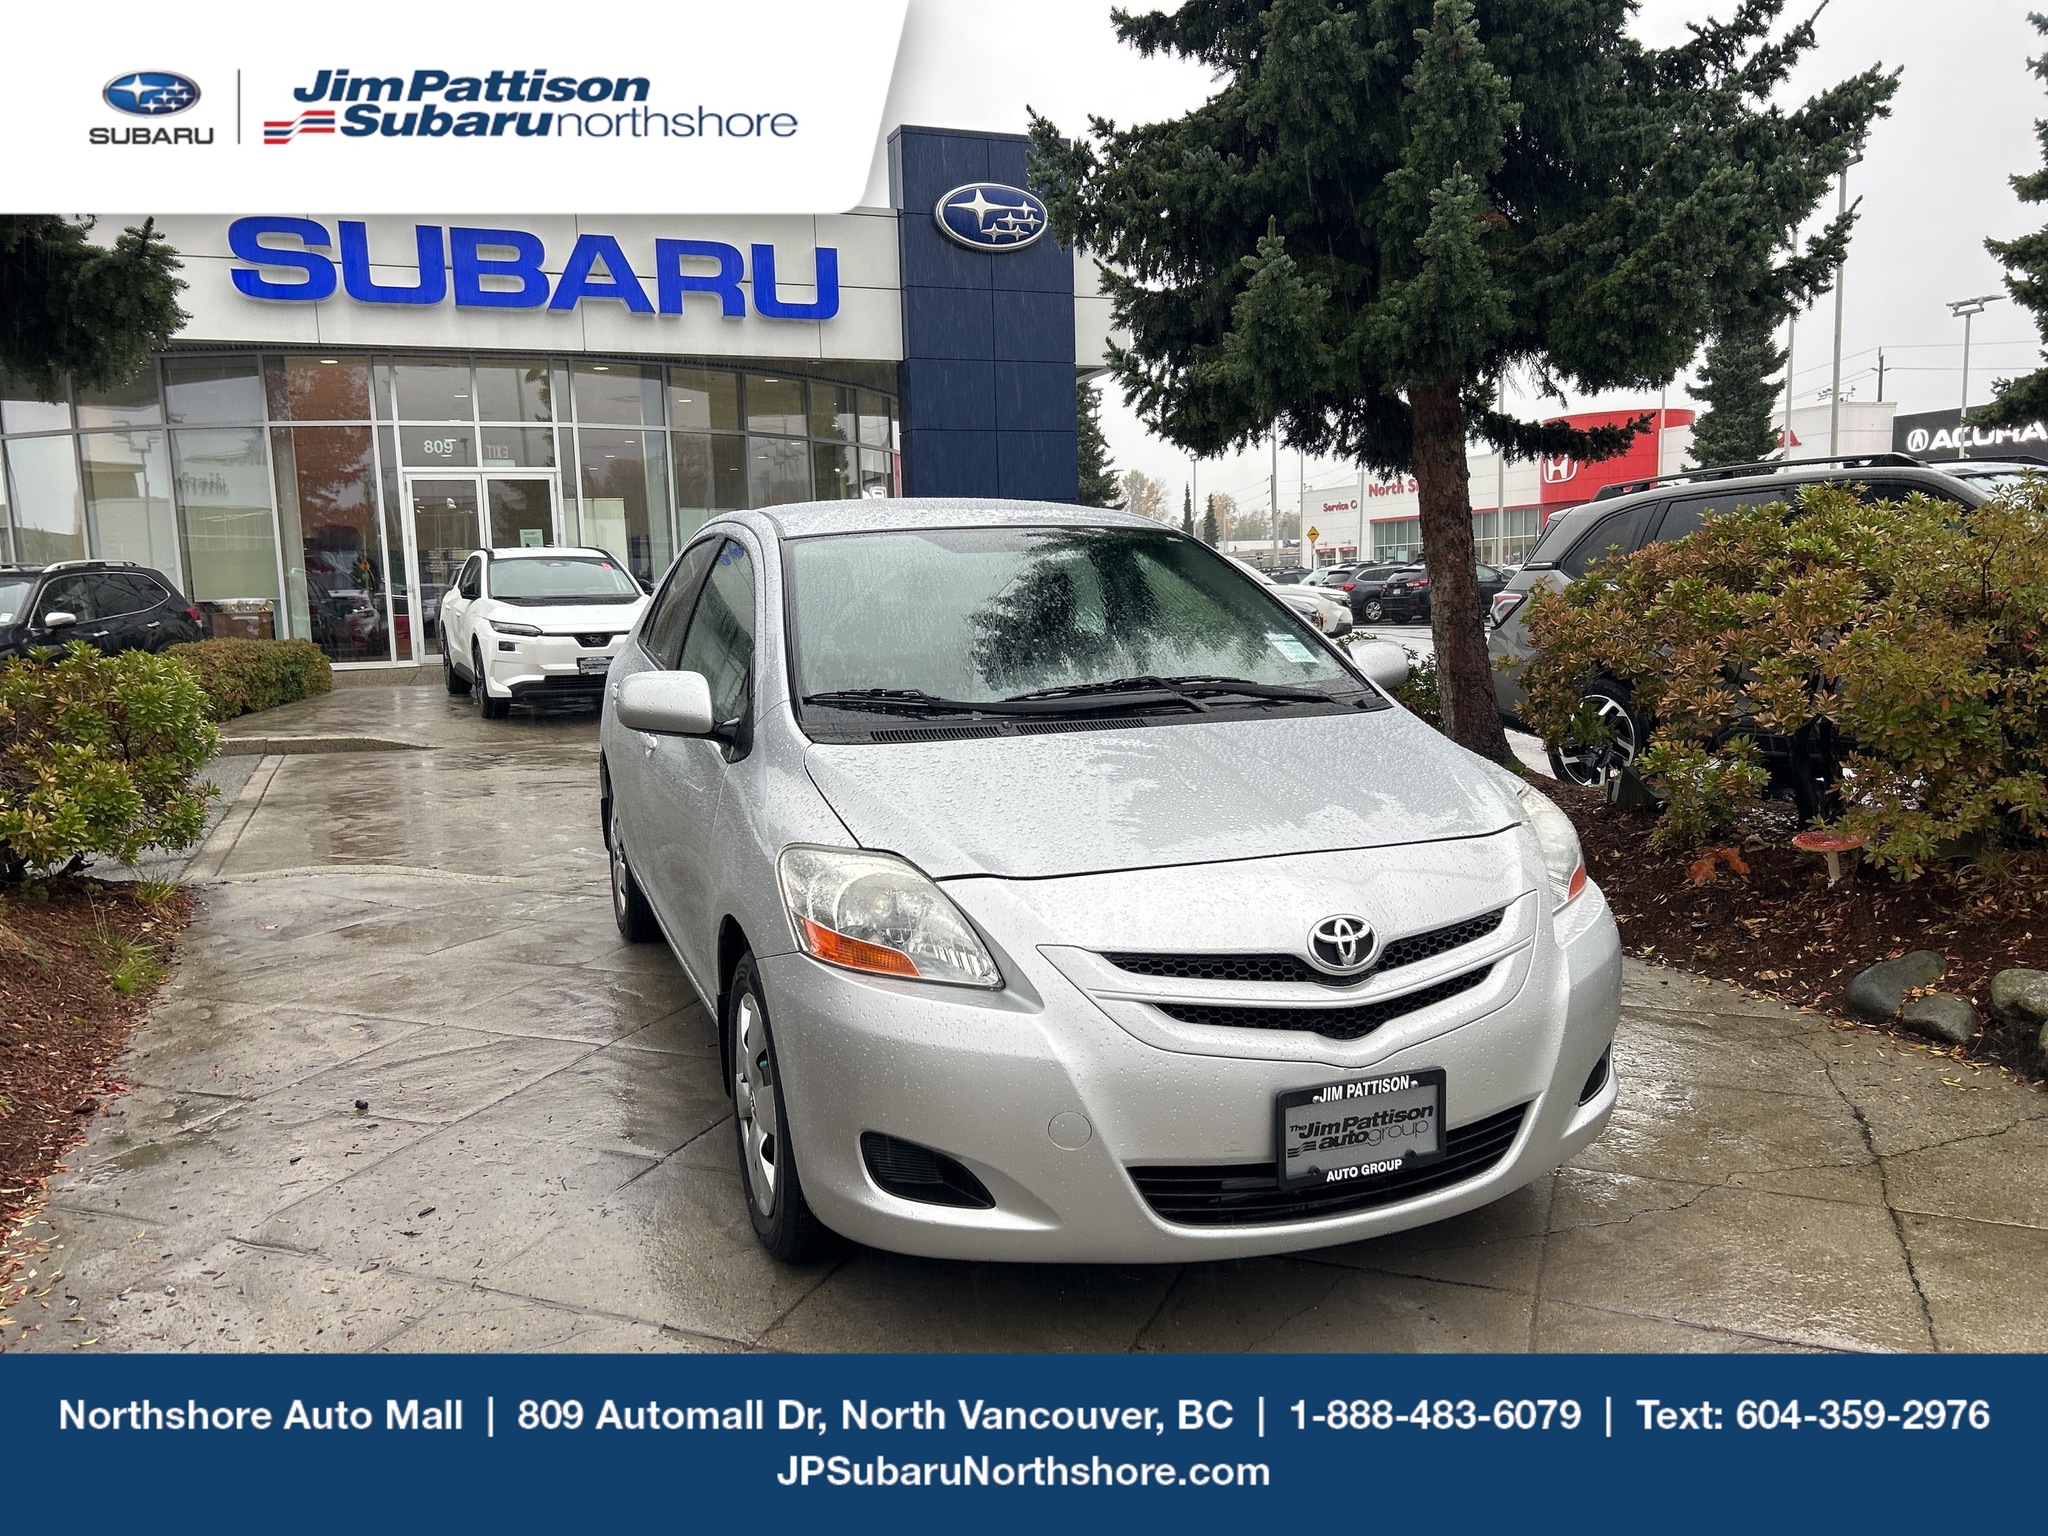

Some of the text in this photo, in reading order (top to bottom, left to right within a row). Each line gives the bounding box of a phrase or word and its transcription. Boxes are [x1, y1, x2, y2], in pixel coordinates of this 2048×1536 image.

[229, 216, 840, 320] SUBARU
[423, 440, 453, 453] 809
[1368, 480, 1404, 497] North
[1322, 501, 1349, 512] Service
[1319, 1075, 1410, 1103] JIM PATTISON
[1289, 1104, 1434, 1139] The Jim Pattison
[1326, 1158, 1403, 1183] AUTO GROUP
